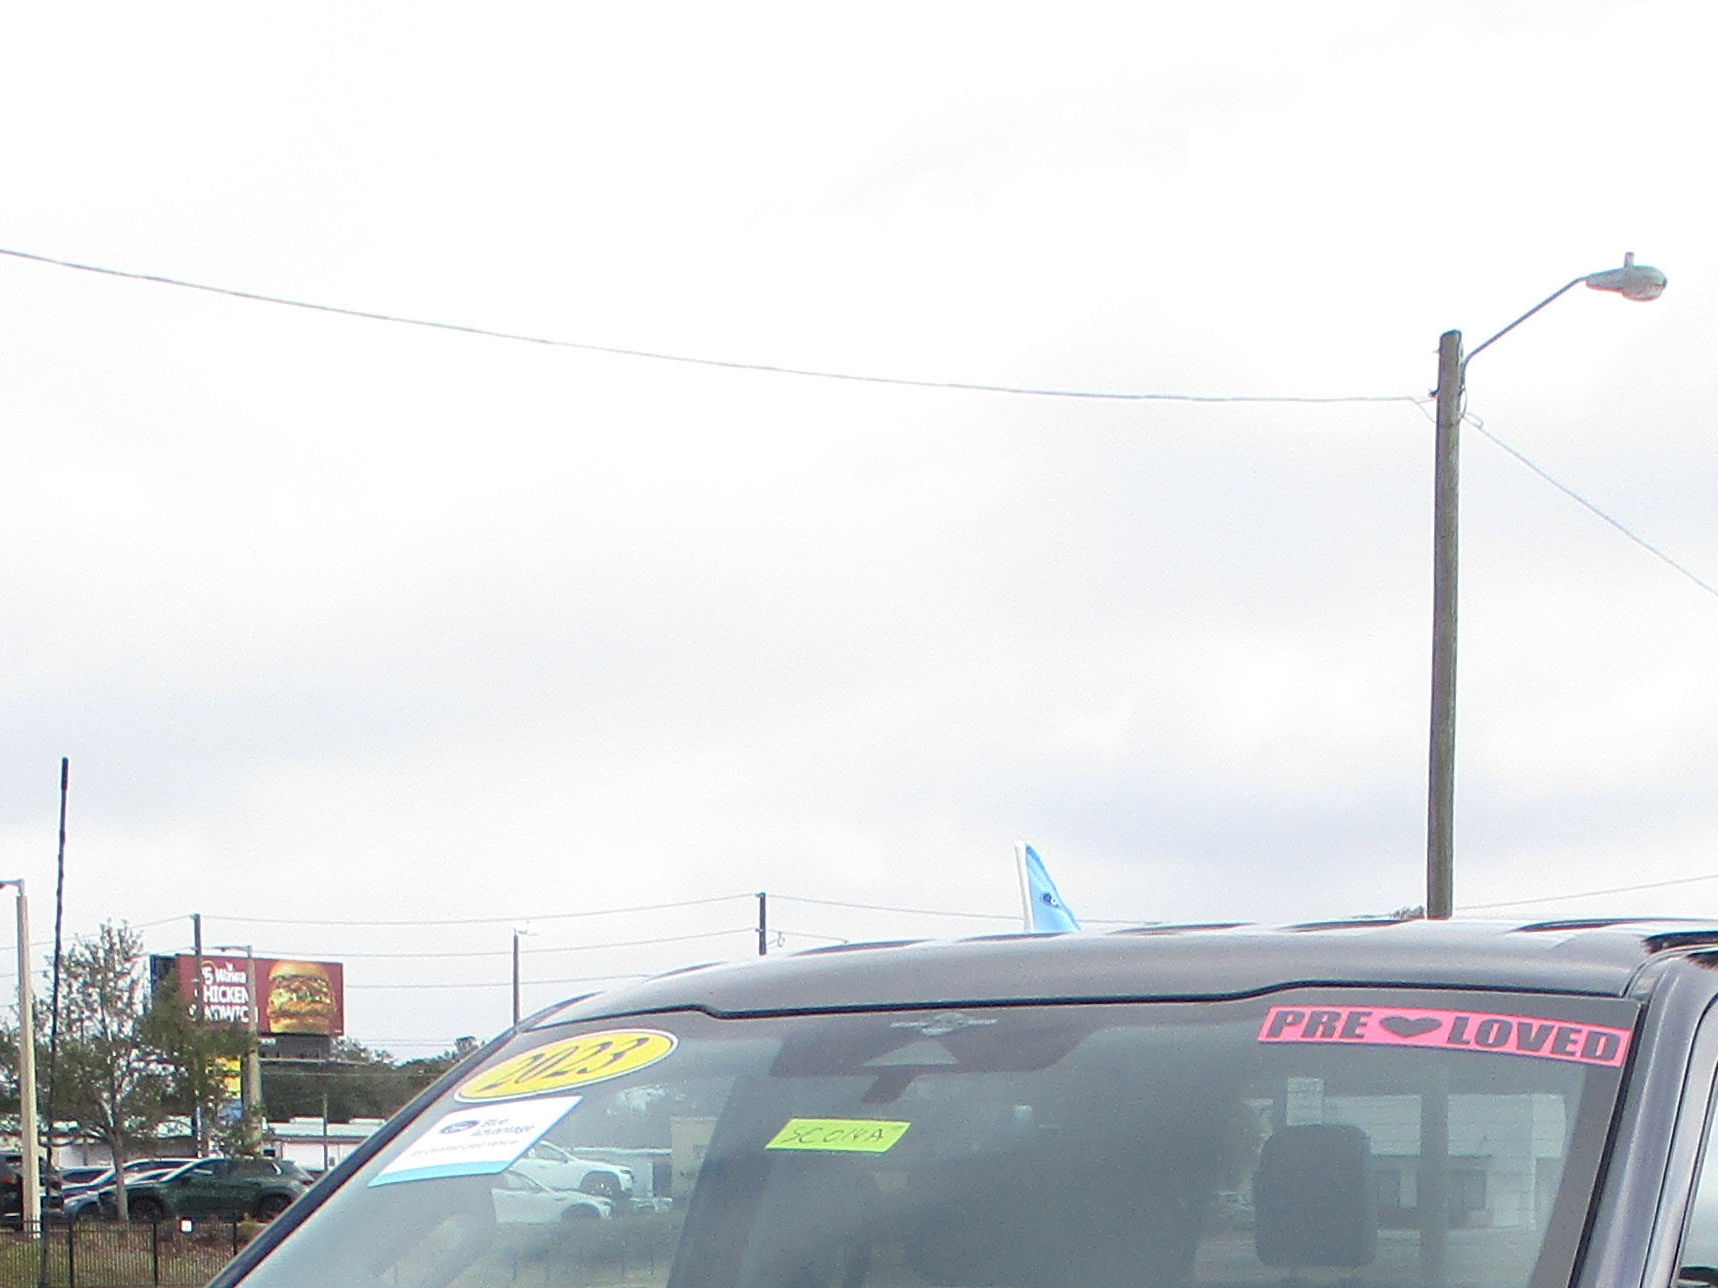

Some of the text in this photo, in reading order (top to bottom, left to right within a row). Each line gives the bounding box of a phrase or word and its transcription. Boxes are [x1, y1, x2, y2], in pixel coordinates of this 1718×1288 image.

[194, 985, 249, 1004] HICKEN
[1265, 1009, 1622, 1061] PRE LOVED
[476, 1036, 651, 1094] 2023
